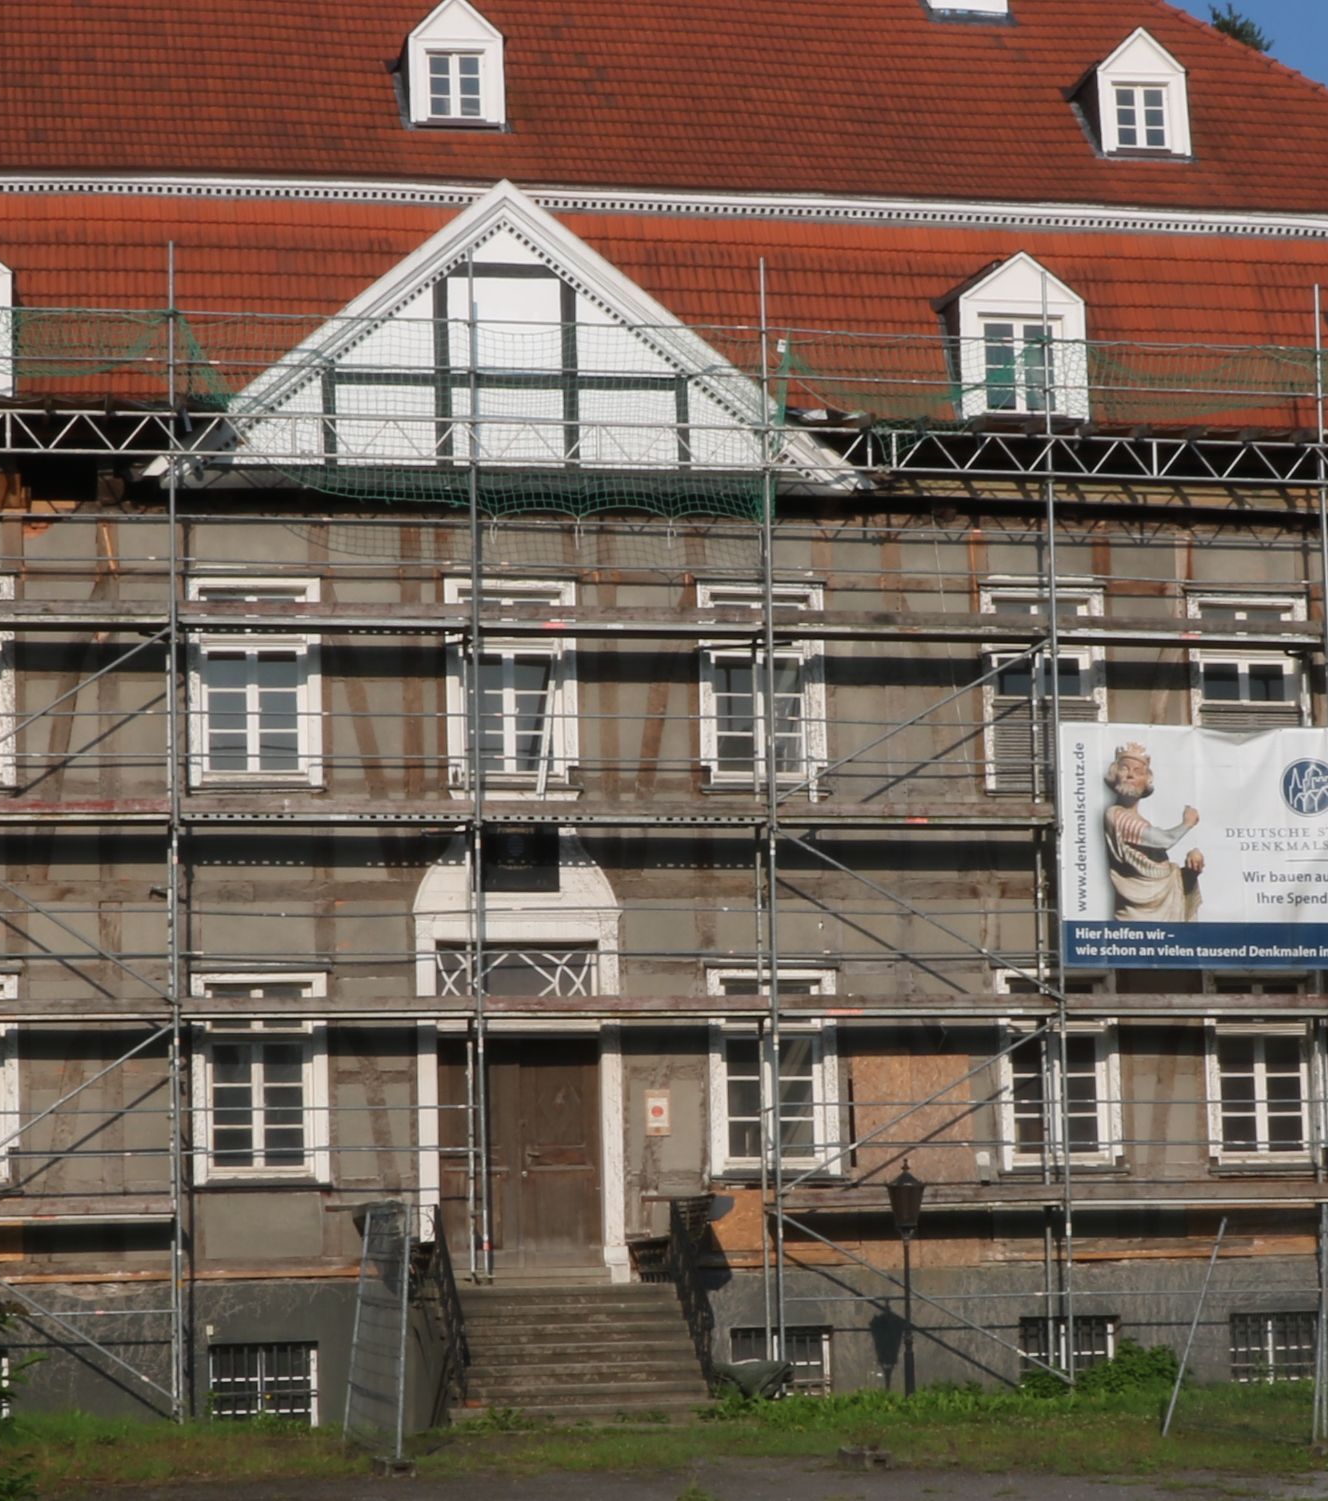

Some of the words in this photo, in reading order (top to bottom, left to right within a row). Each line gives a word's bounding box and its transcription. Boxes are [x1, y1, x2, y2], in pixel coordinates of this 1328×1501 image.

[1073, 742, 1086, 912] www.denkmalschutz.de
[1226, 828, 1310, 838] DEUTSCHE
[1243, 871, 1266, 883] Wir
[1269, 871, 1312, 883] bauen
[1257, 893, 1283, 904] Ihre
[1075, 928, 1101, 940] Hier
[1104, 928, 1144, 940] helfen
[1146, 929, 1165, 940] wir
[1076, 945, 1098, 956] wie
[1100, 945, 1136, 956] schon
[1139, 948, 1155, 956] an
[1158, 945, 1194, 957] vielen
[1197, 946, 1246, 957] tausend
[1249, 945, 1317, 957] Denkmalen
